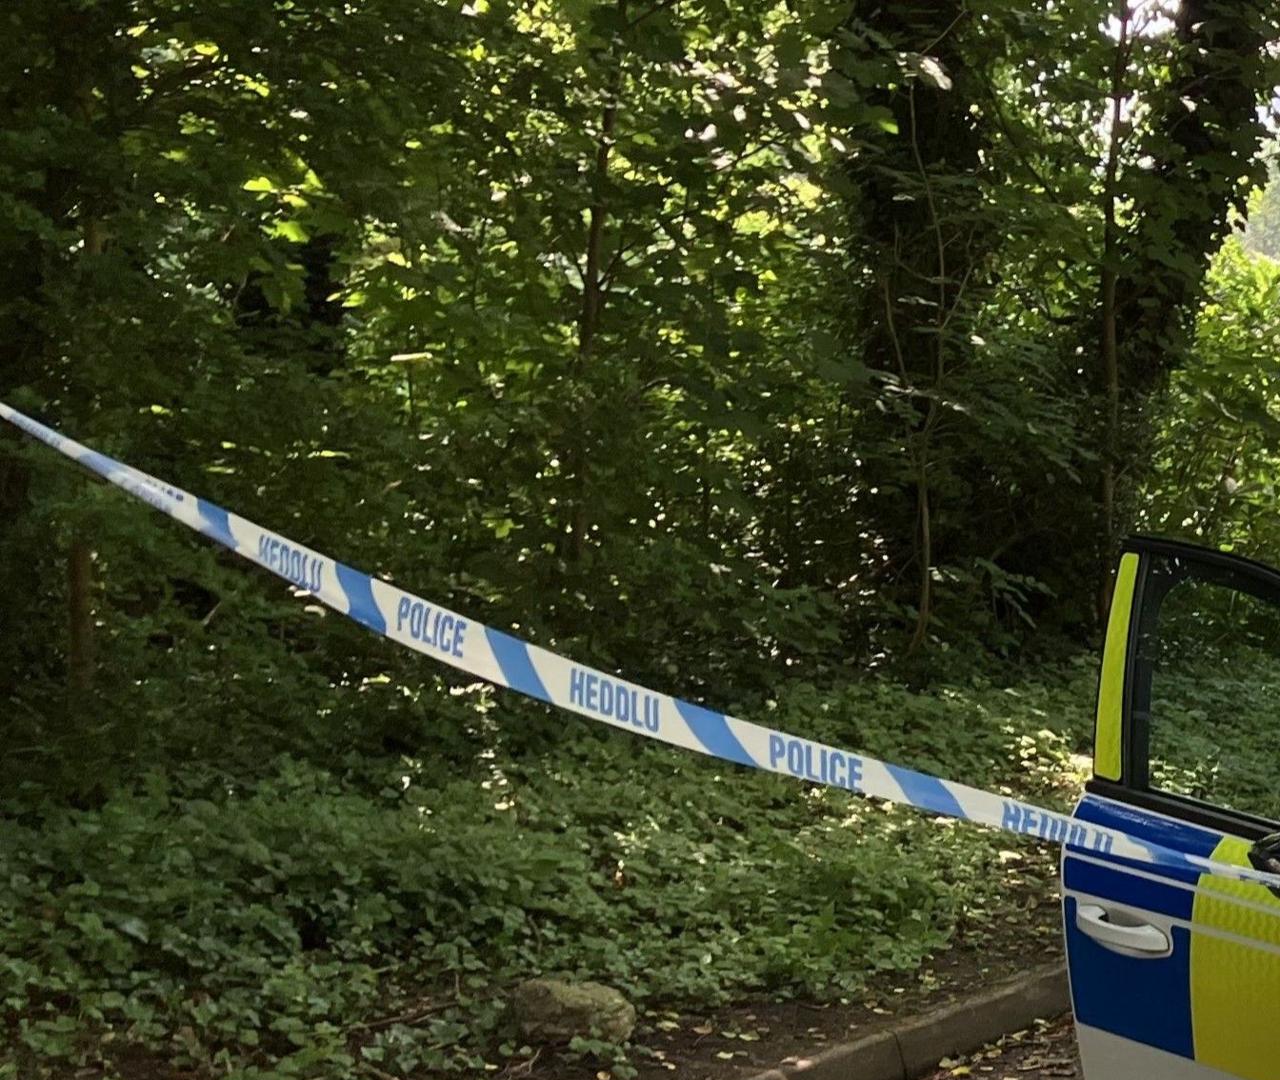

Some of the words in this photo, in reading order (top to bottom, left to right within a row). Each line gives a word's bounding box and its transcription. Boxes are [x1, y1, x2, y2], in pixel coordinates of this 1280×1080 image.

[397, 596, 468, 658] POLICE
[569, 667, 660, 733] HEDDLU
[768, 733, 864, 792] POLICE
